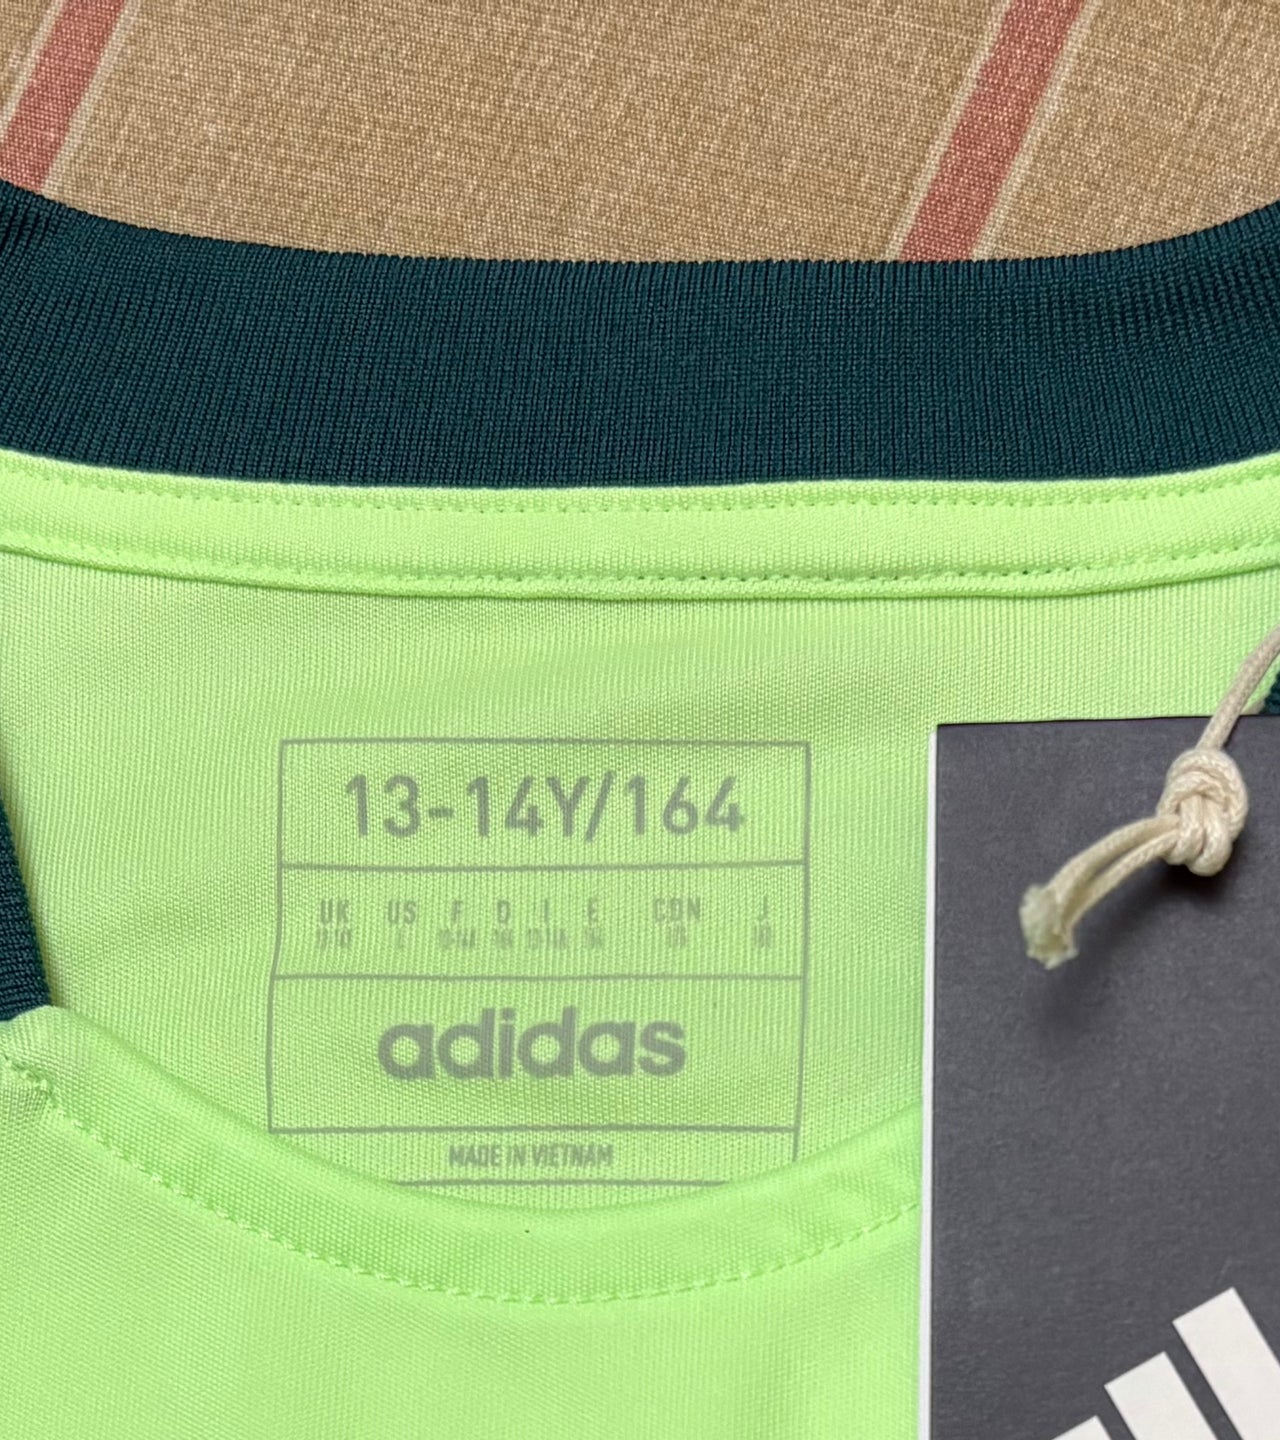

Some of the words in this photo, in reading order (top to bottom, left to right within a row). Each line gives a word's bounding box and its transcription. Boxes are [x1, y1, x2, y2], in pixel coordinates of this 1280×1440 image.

[344, 770, 746, 842] 13-14Y/164
[320, 899, 349, 923] UK
[387, 900, 417, 924] US
[378, 1007, 688, 1081] adidas
[449, 1145, 502, 1168] MADE
[507, 1145, 527, 1167] IN
[531, 1144, 613, 1167] VIETNAM
